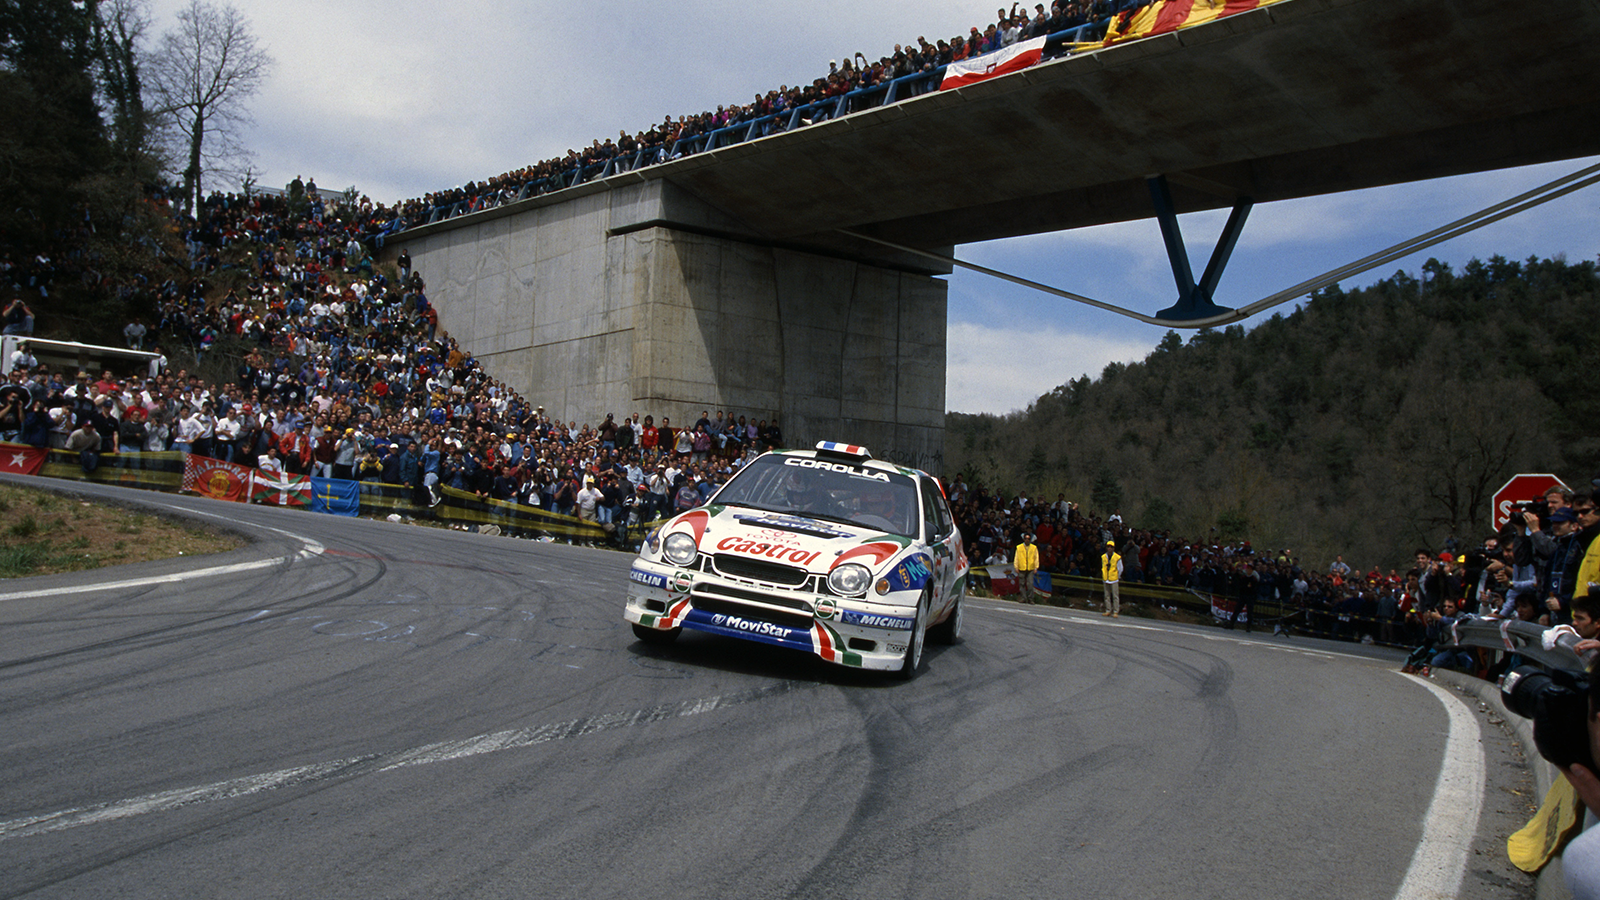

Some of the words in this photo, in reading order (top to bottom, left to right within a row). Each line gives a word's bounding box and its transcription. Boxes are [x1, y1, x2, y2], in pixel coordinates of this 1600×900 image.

[784, 457, 891, 482] COROLLA
[716, 536, 822, 566] Castrol
[746, 533, 801, 547] TOYOTA
[725, 616, 792, 638] MoviStar
[860, 615, 913, 629] MICHELIN
